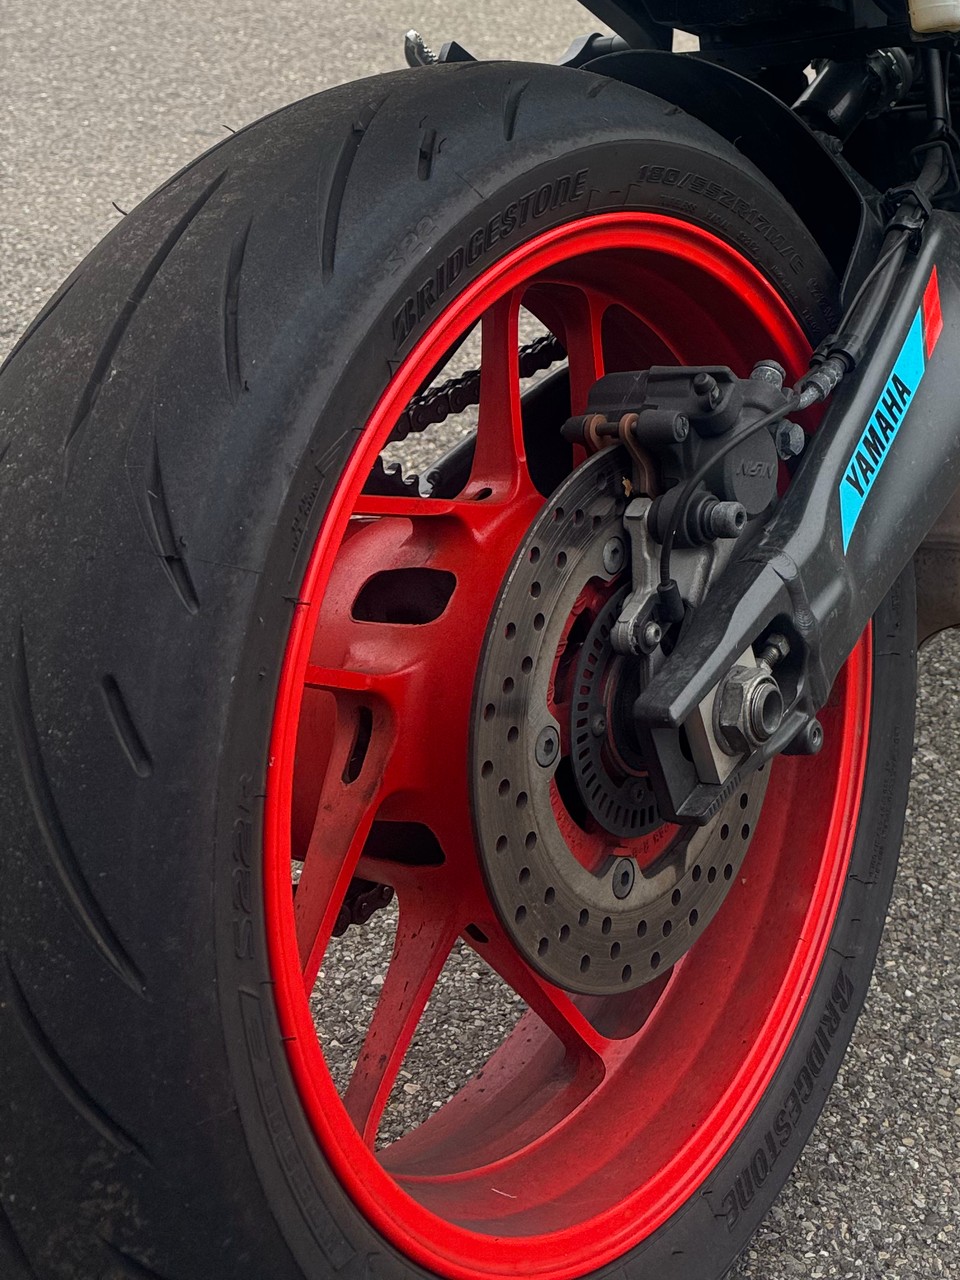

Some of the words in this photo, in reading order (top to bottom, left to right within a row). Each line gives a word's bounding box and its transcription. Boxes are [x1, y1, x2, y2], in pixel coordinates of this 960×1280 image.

[391, 167, 590, 348] BRIDGESTONE
[845, 372, 912, 498] YAMAHA
[720, 968, 856, 1232] BRIDGESTONE
